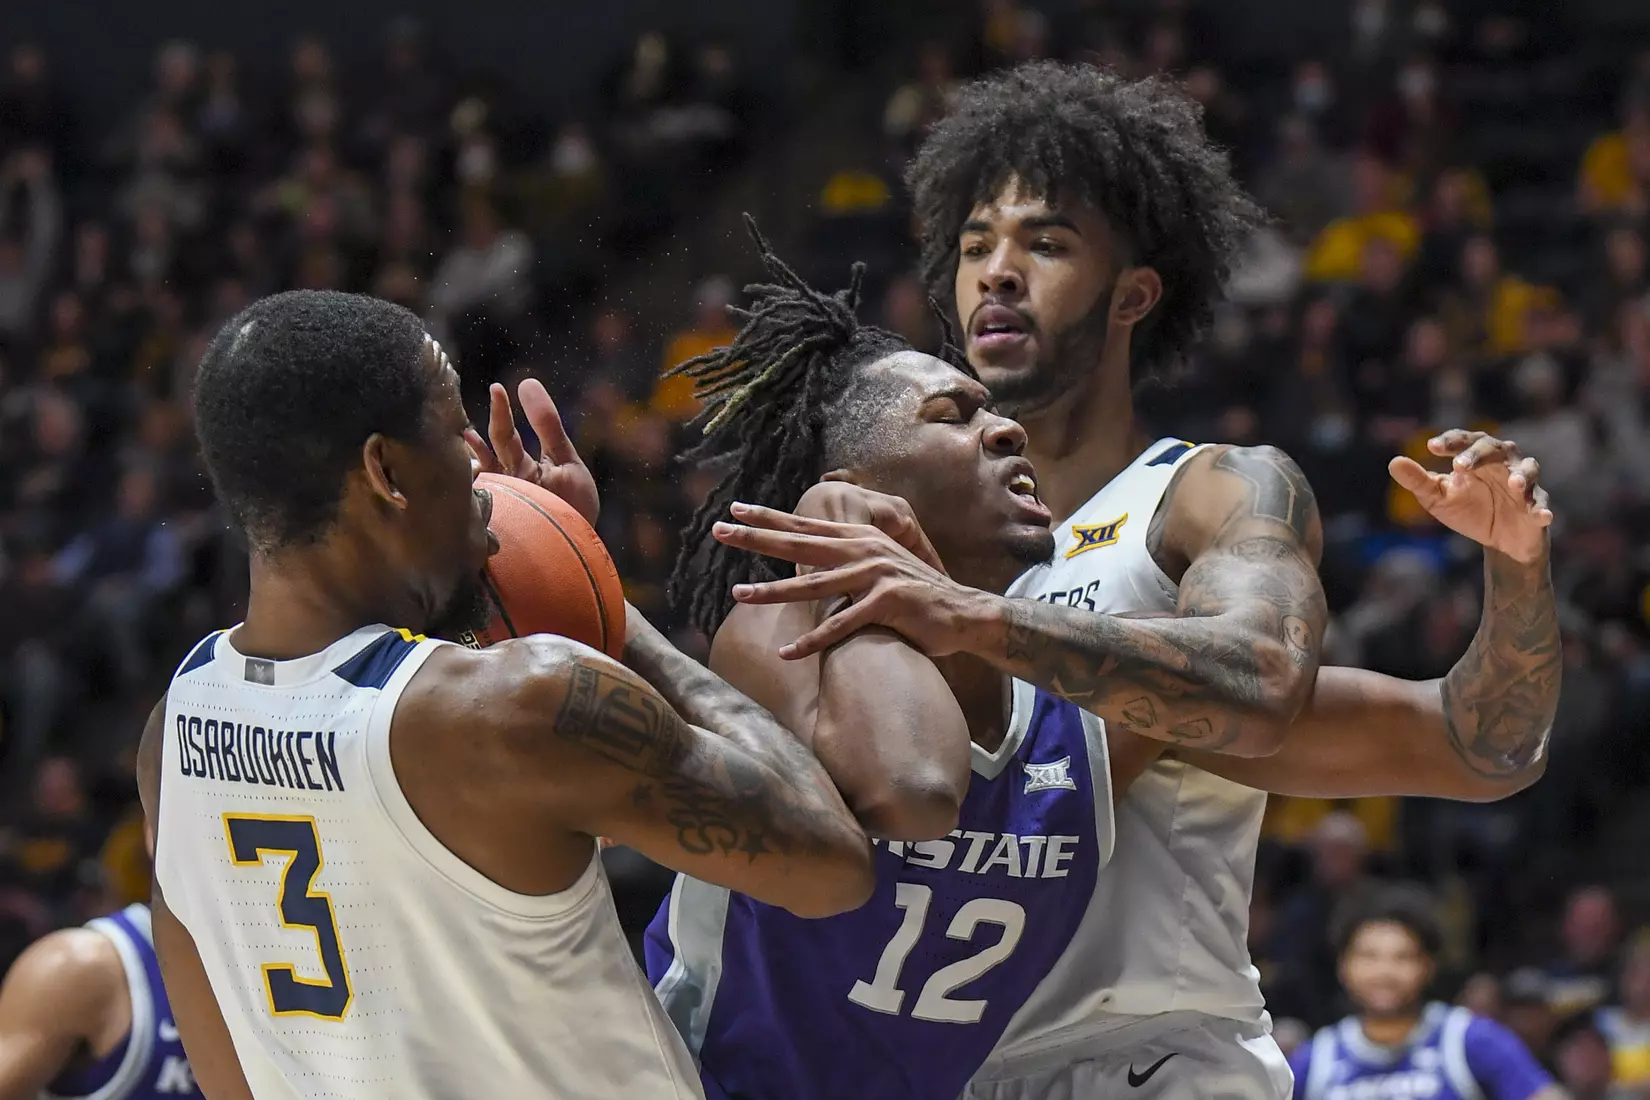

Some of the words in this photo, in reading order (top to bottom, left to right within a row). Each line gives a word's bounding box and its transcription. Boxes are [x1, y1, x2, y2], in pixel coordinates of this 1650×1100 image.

[176, 713, 346, 792] OSABUOHIEN
[221, 811, 354, 1023] 3
[848, 882, 1026, 1024] 12
